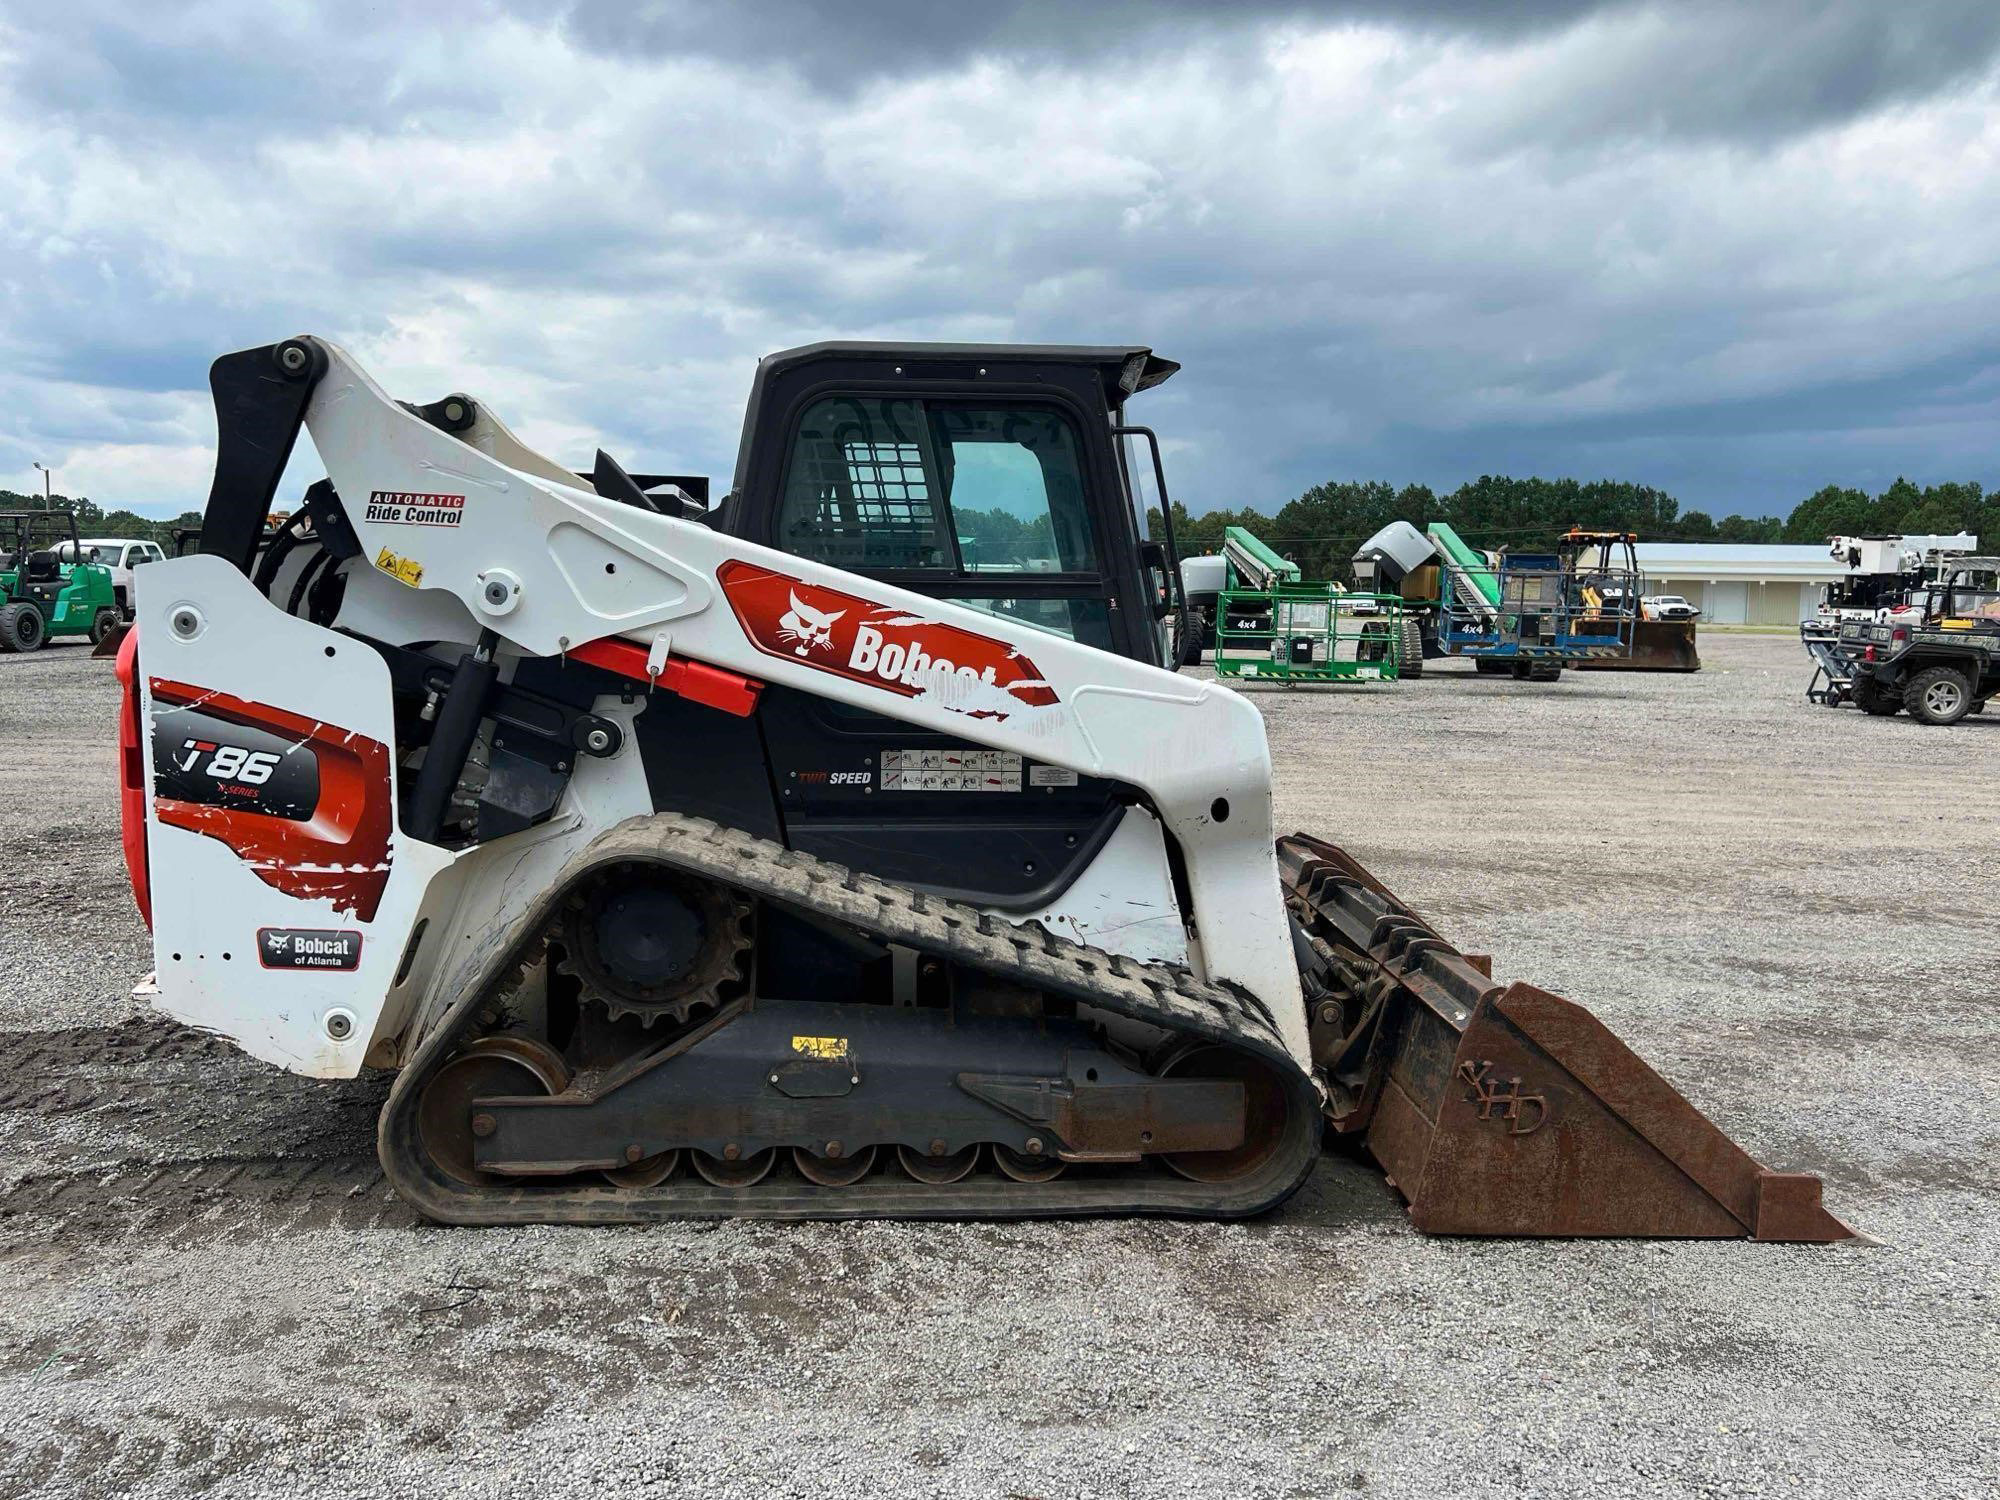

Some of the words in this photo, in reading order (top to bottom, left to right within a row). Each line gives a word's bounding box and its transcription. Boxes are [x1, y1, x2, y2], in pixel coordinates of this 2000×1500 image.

[373, 494, 462, 507] AUTOMATIC
[366, 505, 401, 520] Ride
[405, 507, 462, 524] Control
[1237, 619, 1256, 629] 4x4
[1461, 623, 1483, 634] 4x4
[181, 739, 281, 784] T86
[829, 772, 871, 785] SPEED
[294, 937, 349, 955] Bobcat
[294, 956, 305, 965] of
[307, 956, 342, 966] Atlanta
